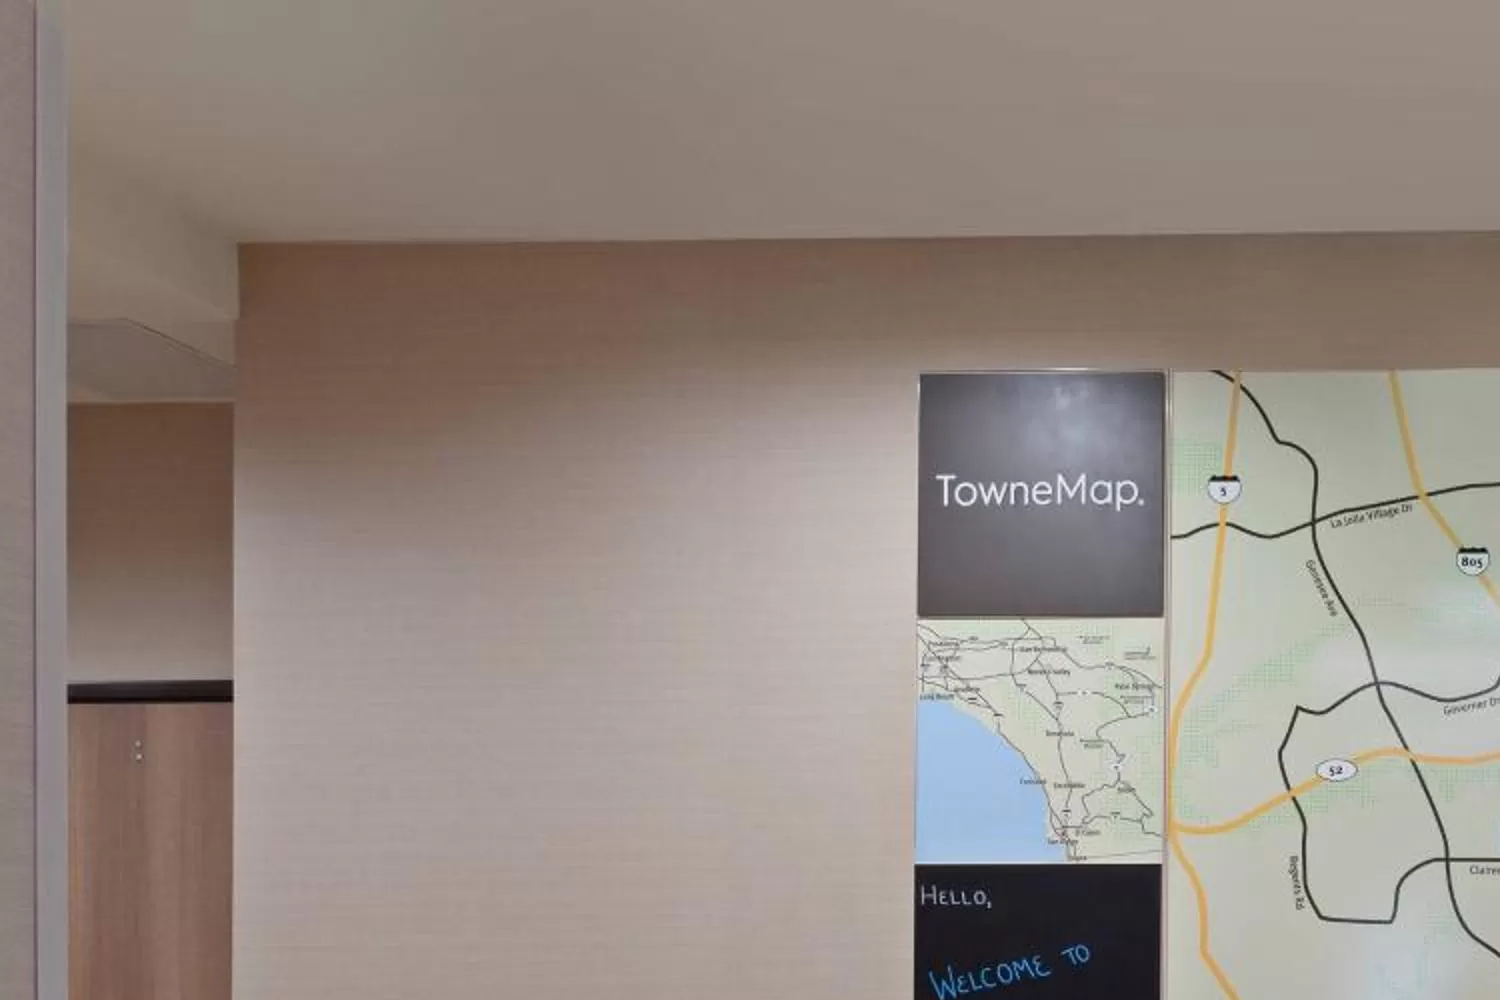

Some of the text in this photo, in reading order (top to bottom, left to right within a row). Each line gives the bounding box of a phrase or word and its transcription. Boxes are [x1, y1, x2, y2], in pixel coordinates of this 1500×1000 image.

[936, 474, 1145, 510] TowneMap.
[1219, 487, 1227, 497] 5
[1461, 556, 1483, 569] 805
[1328, 763, 1343, 777] 52
[1060, 945, 1091, 966] TO
